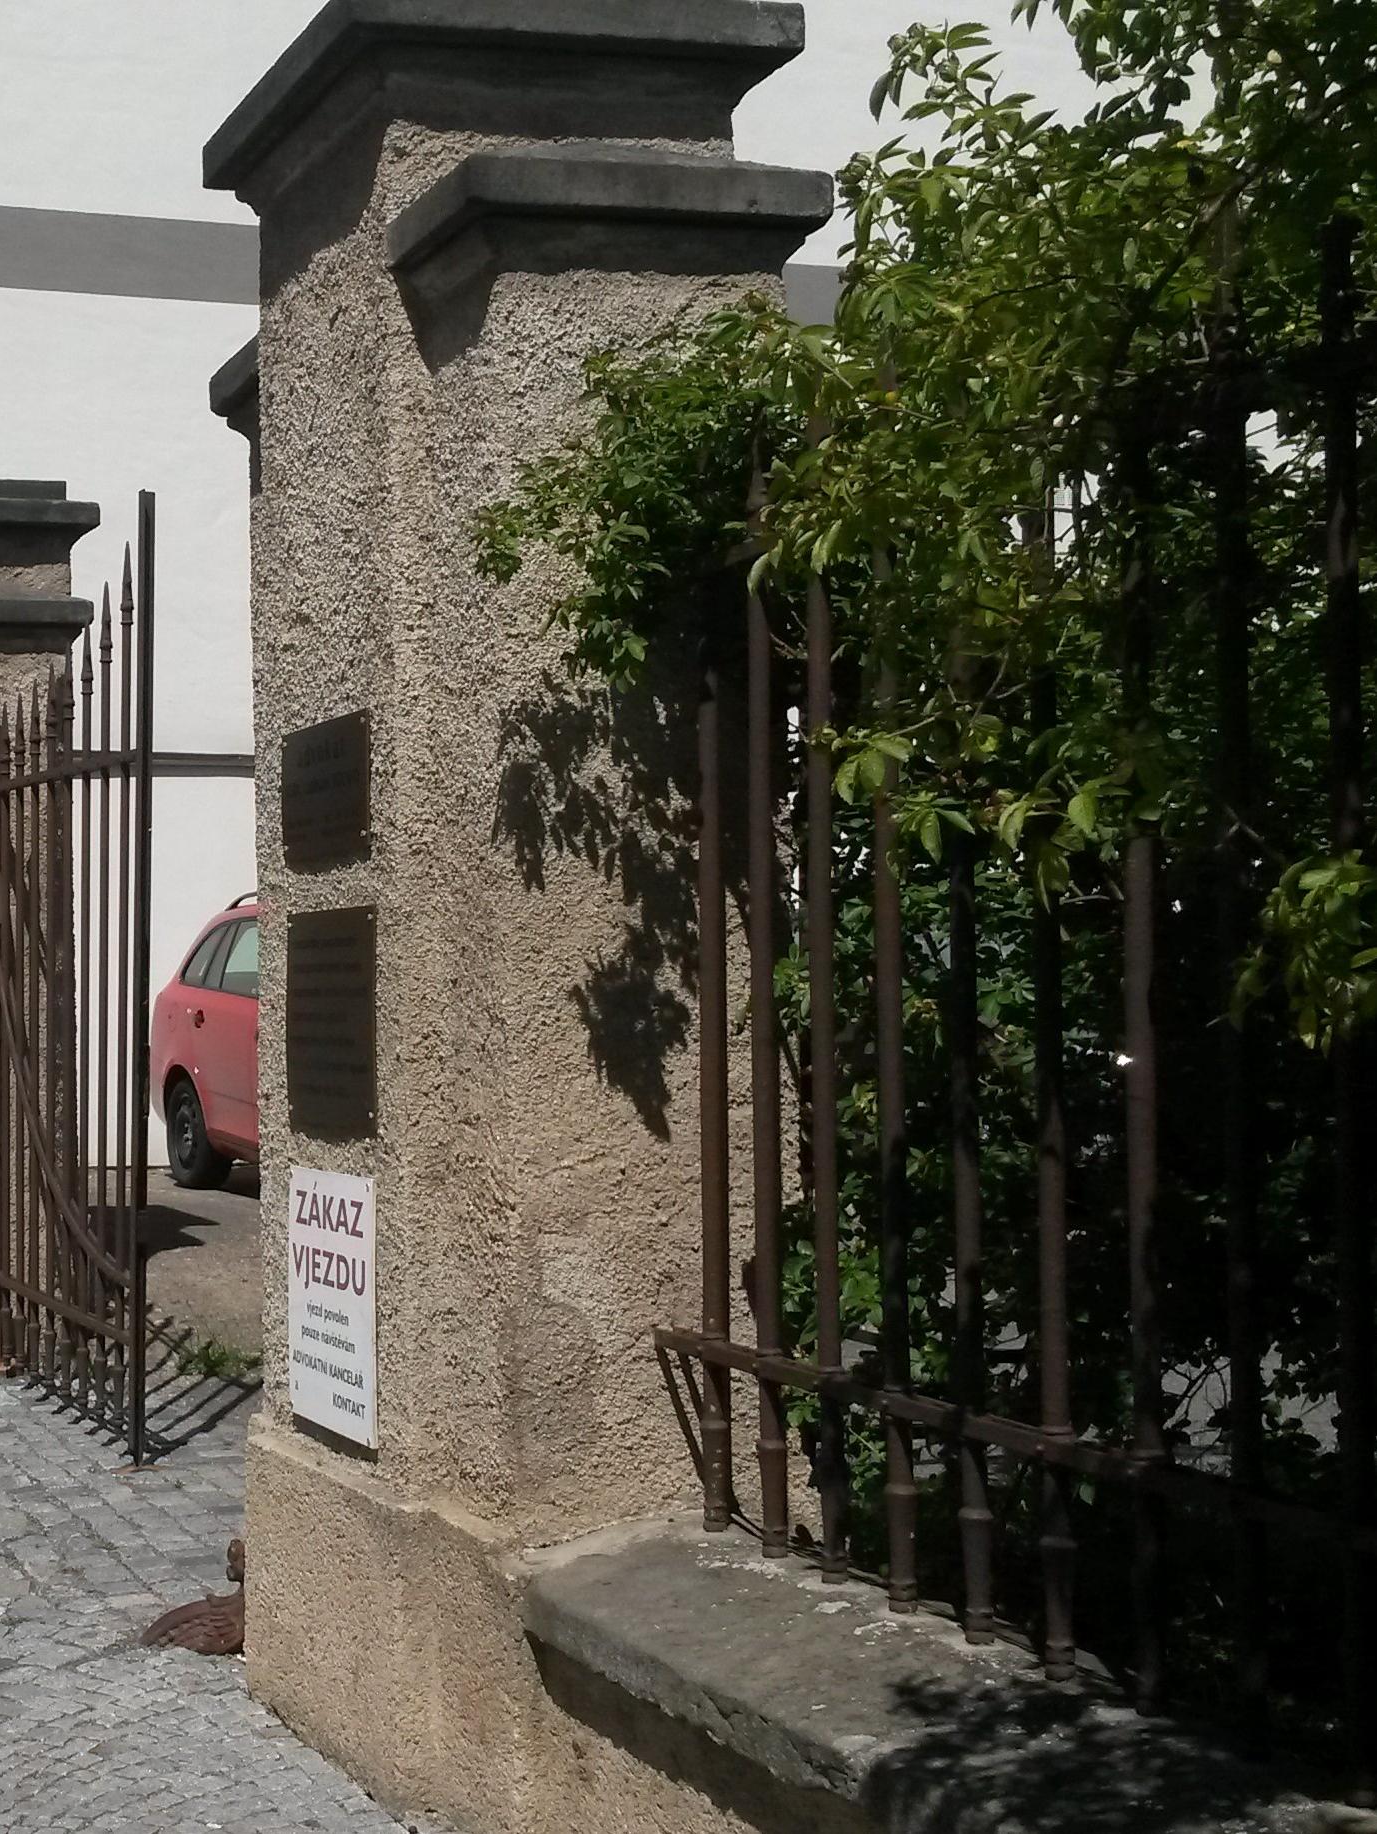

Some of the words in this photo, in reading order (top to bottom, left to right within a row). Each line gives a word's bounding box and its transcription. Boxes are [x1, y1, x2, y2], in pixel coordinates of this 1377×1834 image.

[295, 1181, 364, 1239] ZÁKAZ
[292, 1242, 366, 1297] VJEZDU
[306, 1299, 323, 1318] vjezd
[324, 1308, 349, 1327] povolen
[301, 1325, 320, 1341] pouze
[292, 1349, 328, 1375] ADVOKÁTNÍ
[332, 1392, 366, 1420] KONTAKT
